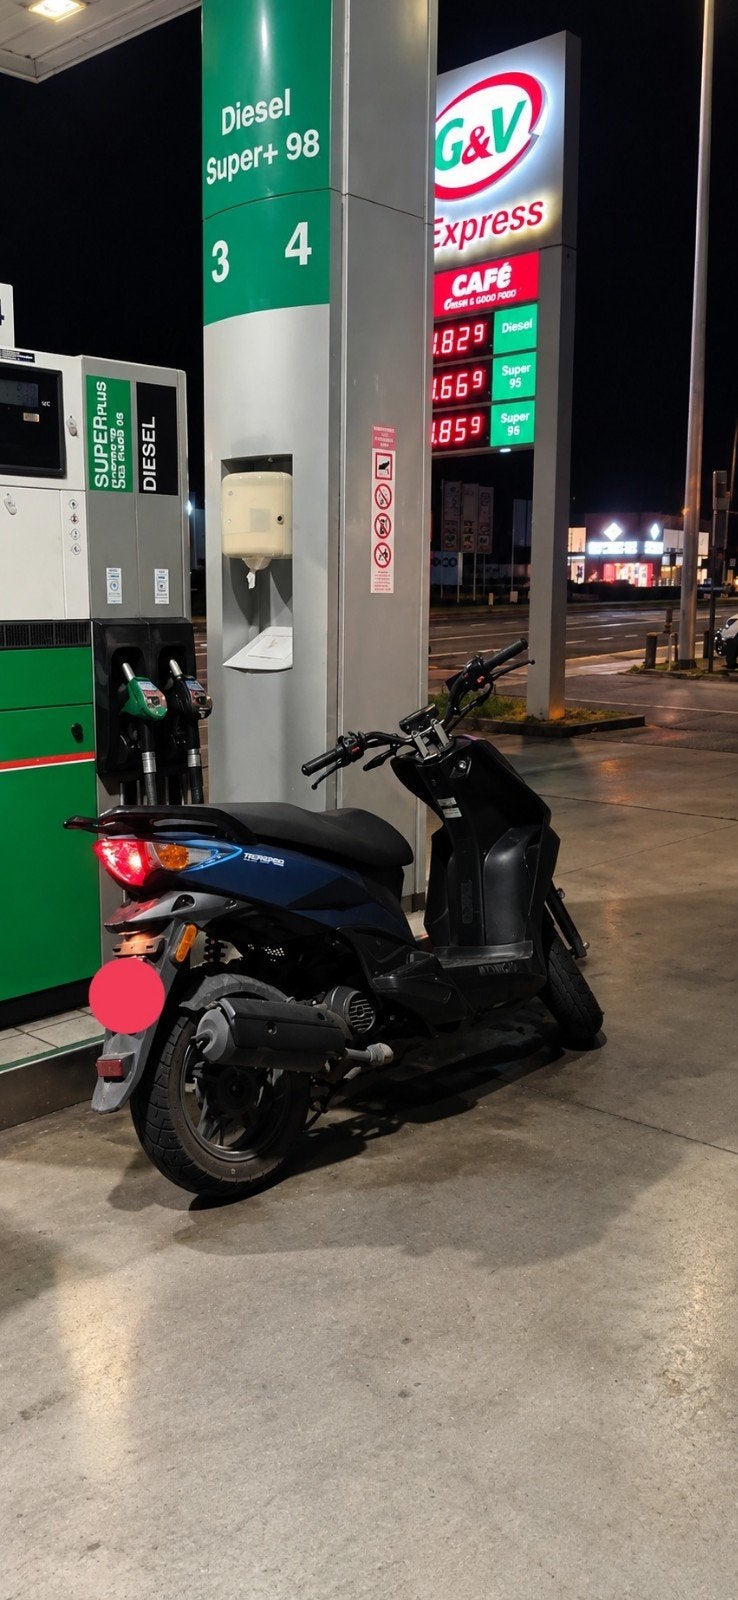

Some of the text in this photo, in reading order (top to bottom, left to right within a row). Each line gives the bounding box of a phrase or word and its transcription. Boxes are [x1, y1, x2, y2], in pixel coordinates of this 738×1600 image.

[221, 88, 291, 136] Diesel
[206, 129, 320, 185] Super+ 98
[435, 99, 527, 171] G&V
[285, 221, 312, 266] 4
[433, 201, 543, 250] Express
[211, 239, 230, 283] 3
[451, 262, 512, 297] CAFÉ
[501, 318, 533, 334] Diesel
[501, 363, 532, 378] Super
[509, 377, 522, 389] 95
[501, 412, 530, 424] Super
[142, 416, 157, 491] DIESEL
